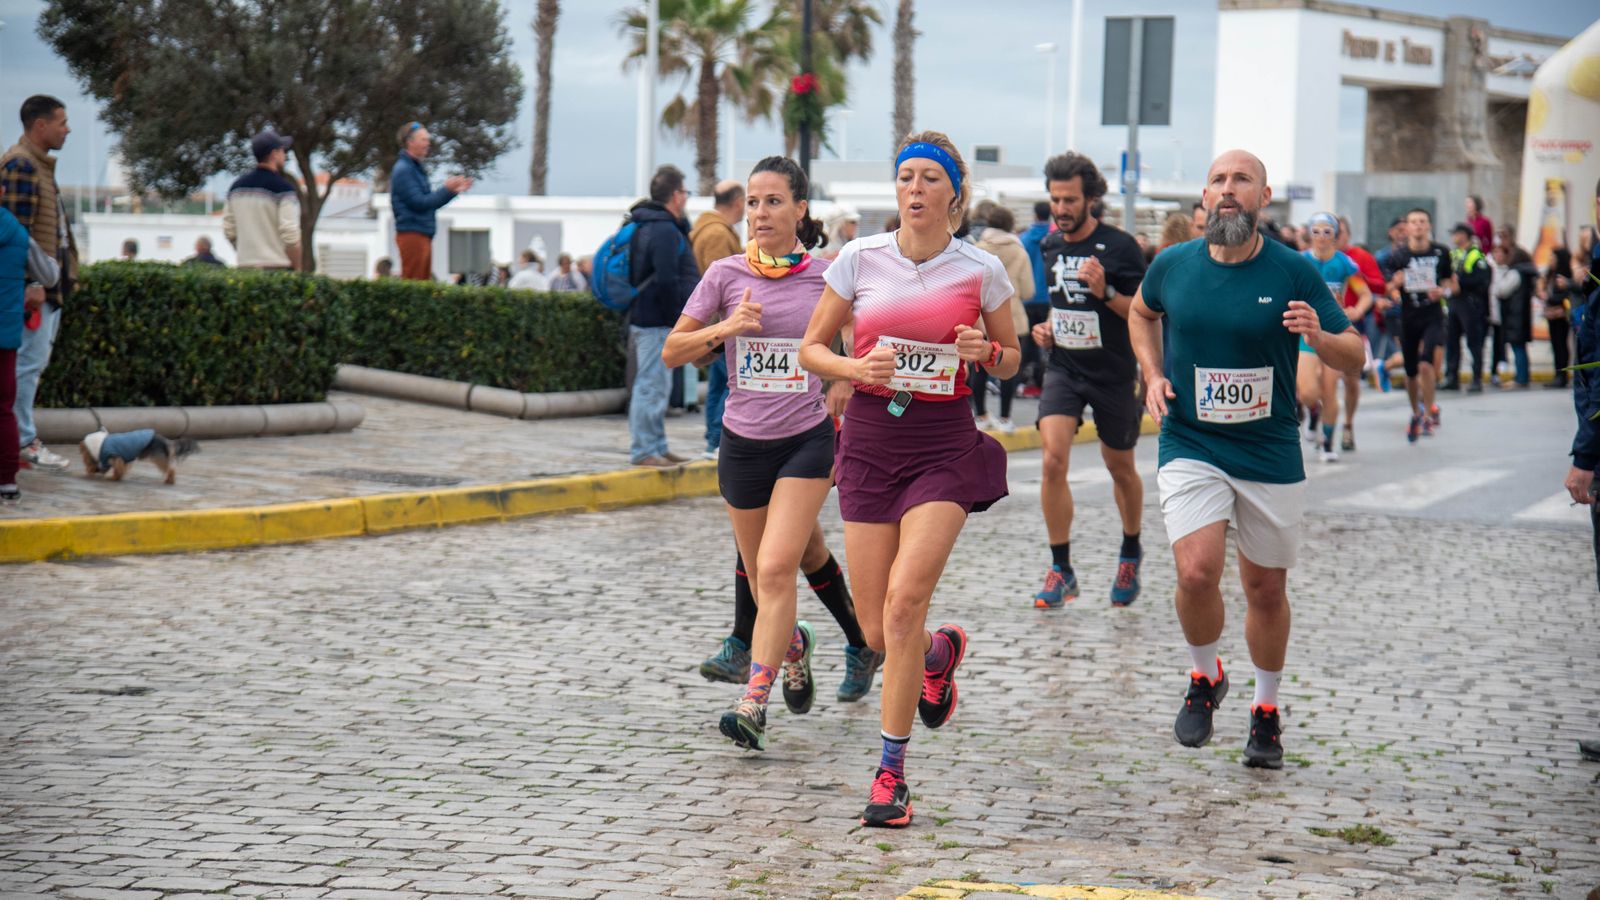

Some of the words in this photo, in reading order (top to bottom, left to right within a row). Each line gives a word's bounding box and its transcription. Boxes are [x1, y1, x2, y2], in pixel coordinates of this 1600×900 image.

[1062, 319, 1086, 336] 342
[747, 341, 770, 352] XIV
[891, 342, 917, 353] XIV
[753, 352, 790, 374] 344
[895, 352, 937, 372] 302
[1208, 372, 1232, 383] XIV
[1214, 383, 1253, 404] 490
